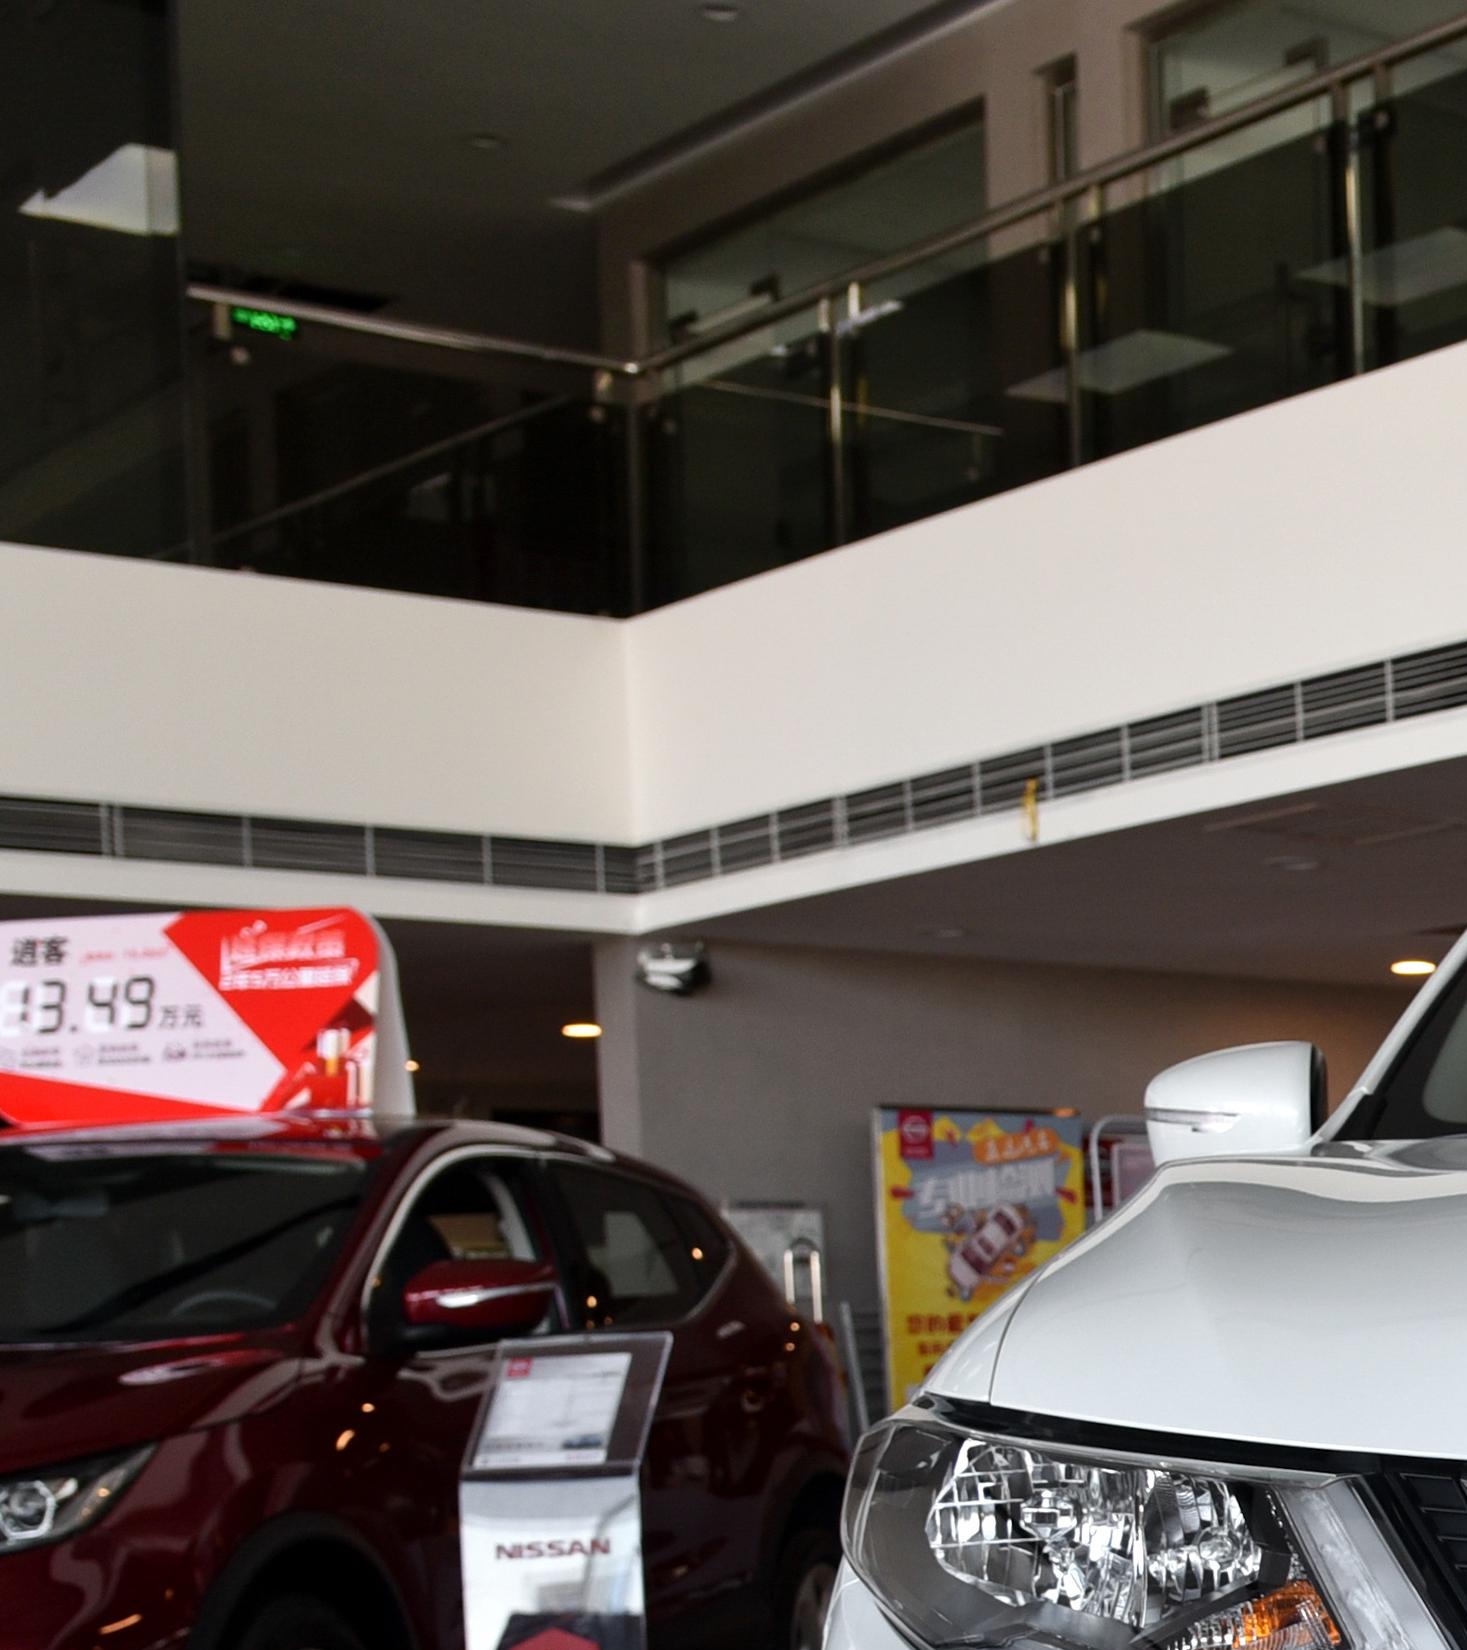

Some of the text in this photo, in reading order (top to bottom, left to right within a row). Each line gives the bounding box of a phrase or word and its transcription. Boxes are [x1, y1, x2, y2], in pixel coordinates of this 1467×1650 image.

[11, 937, 68, 967] 逍客
[159, 1004, 204, 1028] 万元
[496, 1539, 611, 1560] NISSAN
